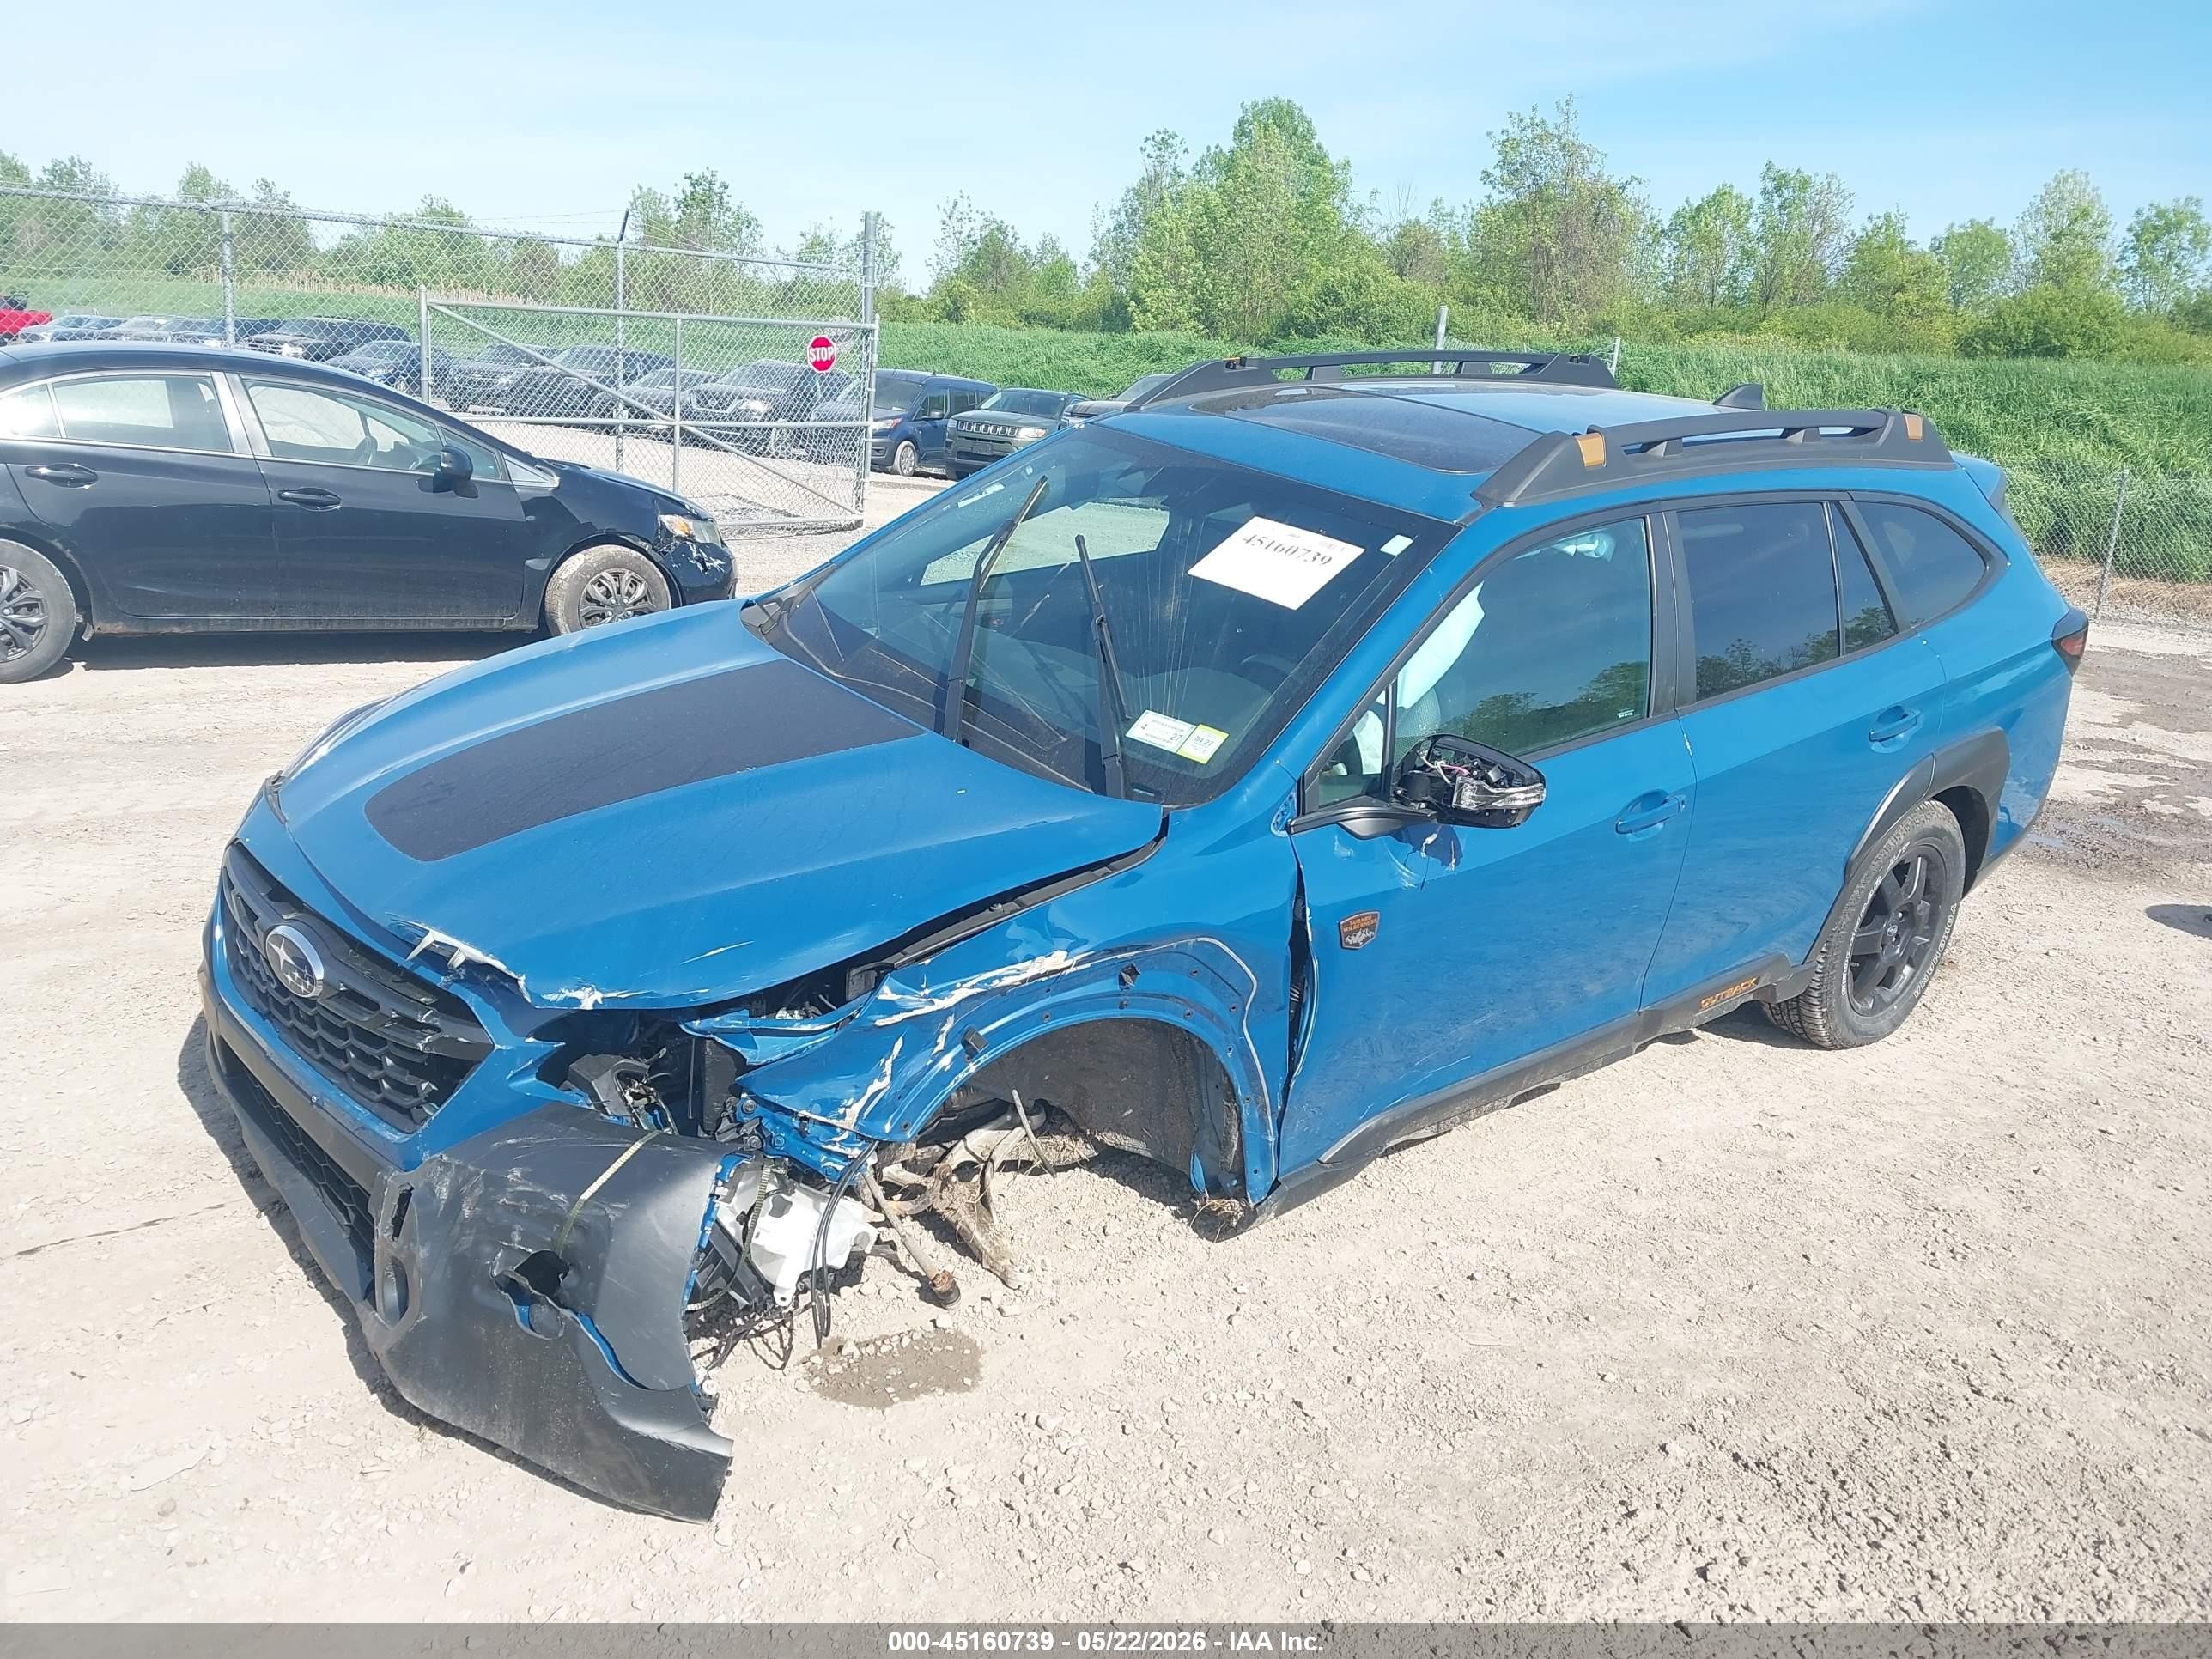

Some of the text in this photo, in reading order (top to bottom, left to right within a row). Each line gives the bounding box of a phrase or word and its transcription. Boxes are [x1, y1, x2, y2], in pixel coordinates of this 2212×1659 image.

[810, 346, 834, 362] STOP
[1243, 534, 1332, 565] 45160739
[1913, 902, 1958, 998] YOKOHAMA
[1700, 977, 1758, 1008] OUTBACK
